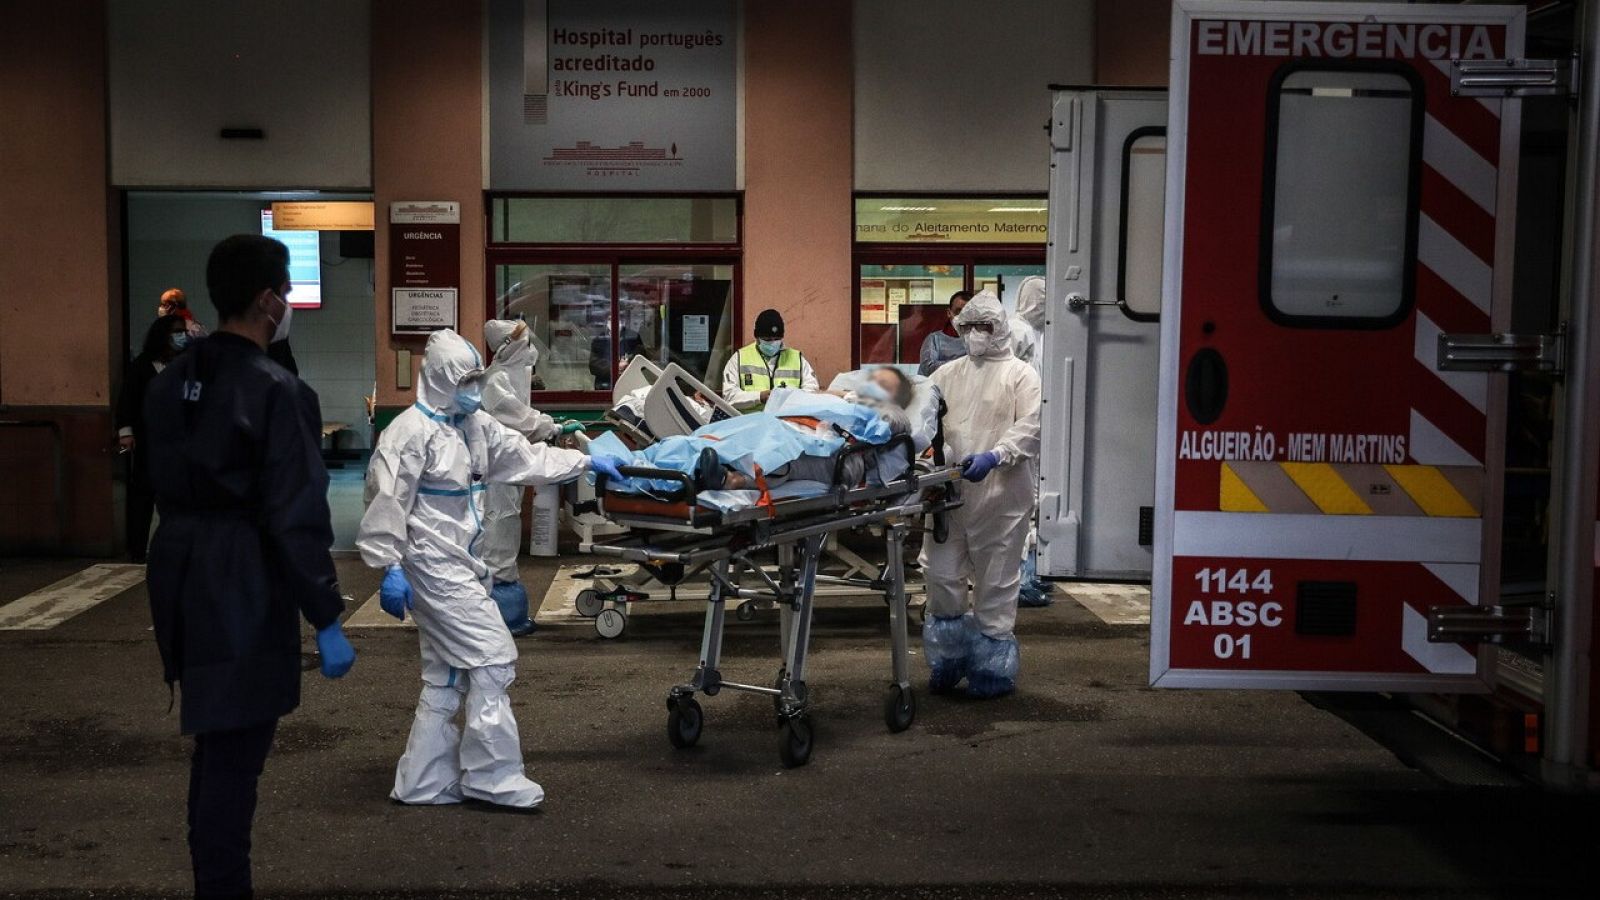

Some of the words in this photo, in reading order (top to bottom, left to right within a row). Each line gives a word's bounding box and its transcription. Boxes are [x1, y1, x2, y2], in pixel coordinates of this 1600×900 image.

[553, 28, 632, 48] Hospital
[640, 30, 723, 49] português
[1198, 15, 1495, 61] EMERGÊNCIA
[553, 55, 655, 71] acreditado
[563, 81, 612, 100] King's
[617, 81, 658, 97] Fund
[663, 88, 680, 97] em
[682, 87, 711, 97] 2000
[403, 231, 443, 241] URGÊNCIA
[892, 222, 910, 233] do
[914, 222, 989, 233] Aleitamento
[994, 222, 1047, 233] Materno
[1179, 425, 1275, 460] ALGUEIRÃO
[1288, 433, 1324, 461] MEM
[1329, 434, 1406, 463] MARTINS
[1195, 567, 1273, 594] 1144
[1184, 601, 1283, 628] ABSC
[1213, 634, 1251, 660] 01
